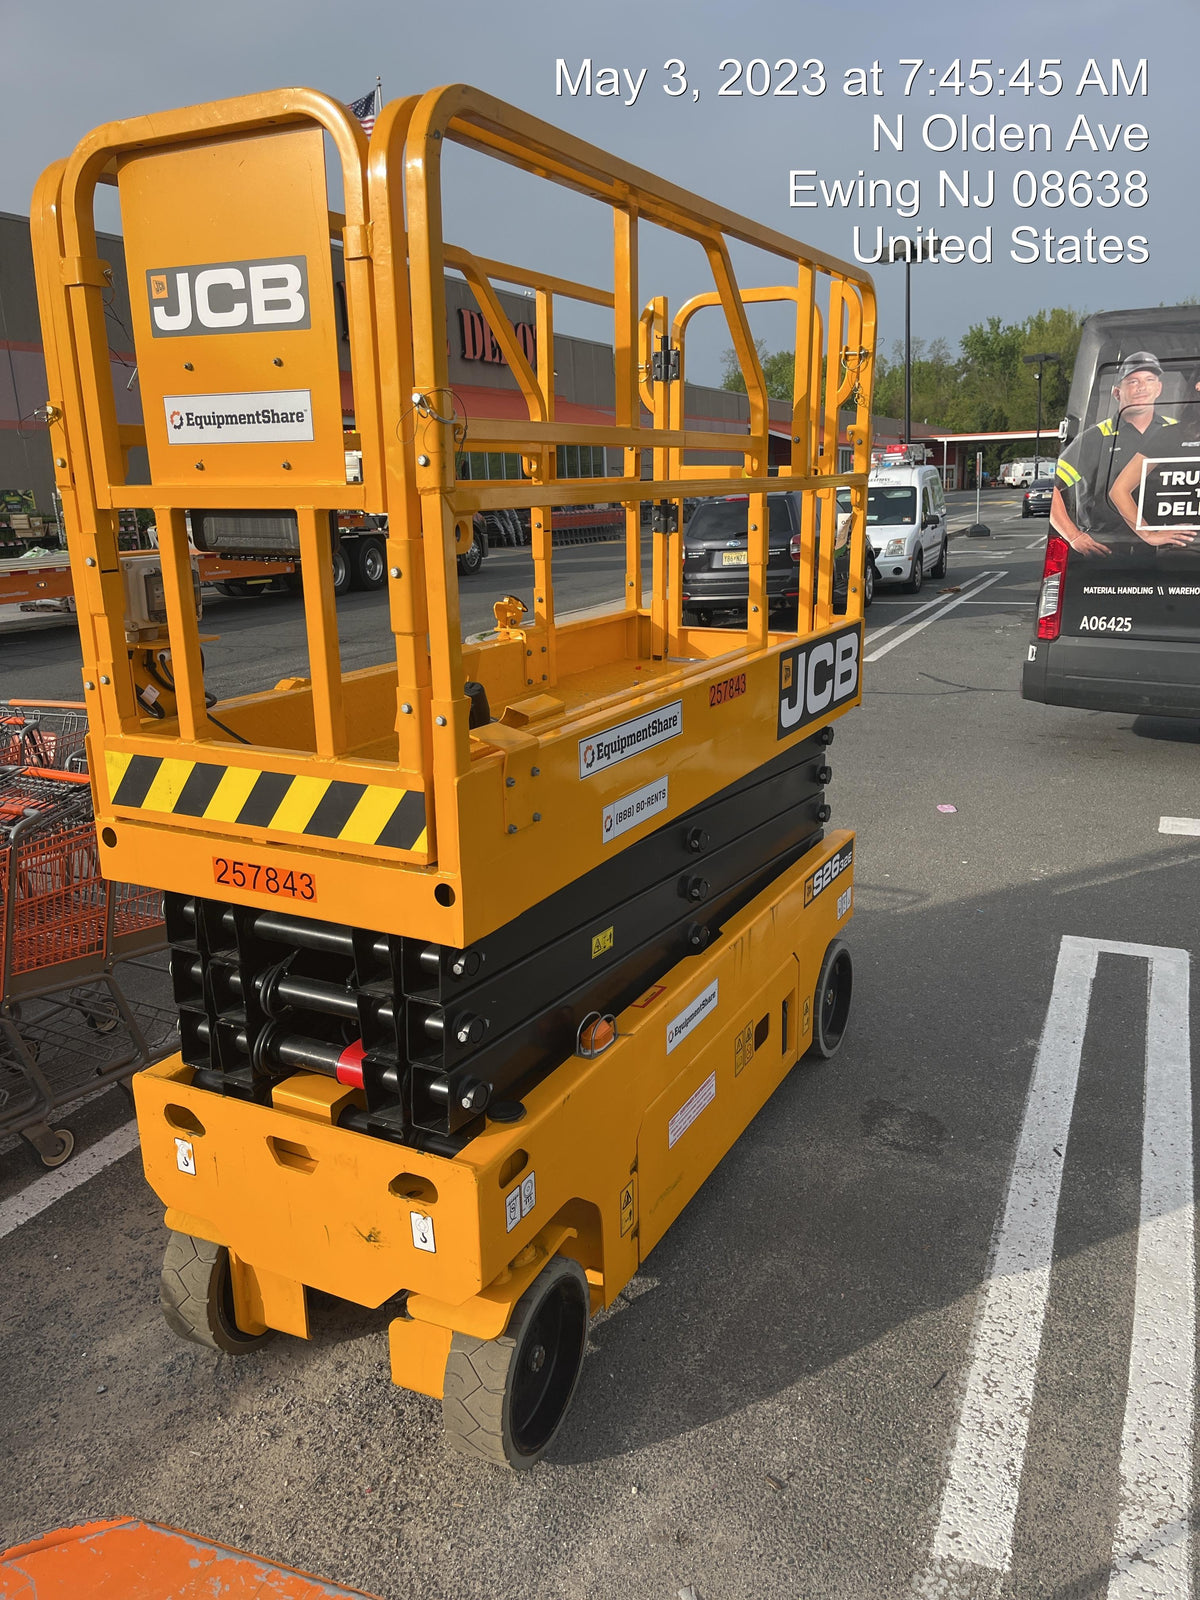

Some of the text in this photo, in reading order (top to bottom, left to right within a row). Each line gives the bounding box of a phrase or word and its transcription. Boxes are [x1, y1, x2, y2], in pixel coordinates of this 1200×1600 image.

[153, 263, 306, 331] JCB
[186, 408, 305, 430] EquipmentShare
[1159, 470, 1200, 486] TRU
[1083, 586, 1116, 595] MATERIAL
[1117, 586, 1153, 595] HANDLING
[1079, 615, 1132, 632] A06425
[709, 673, 747, 707] 257843
[780, 632, 859, 729] JCB
[596, 713, 678, 761] EquipmentShare
[615, 804, 635, 825] (888)
[214, 857, 315, 901] 257843
[674, 990, 716, 1037] EquipmentShare
